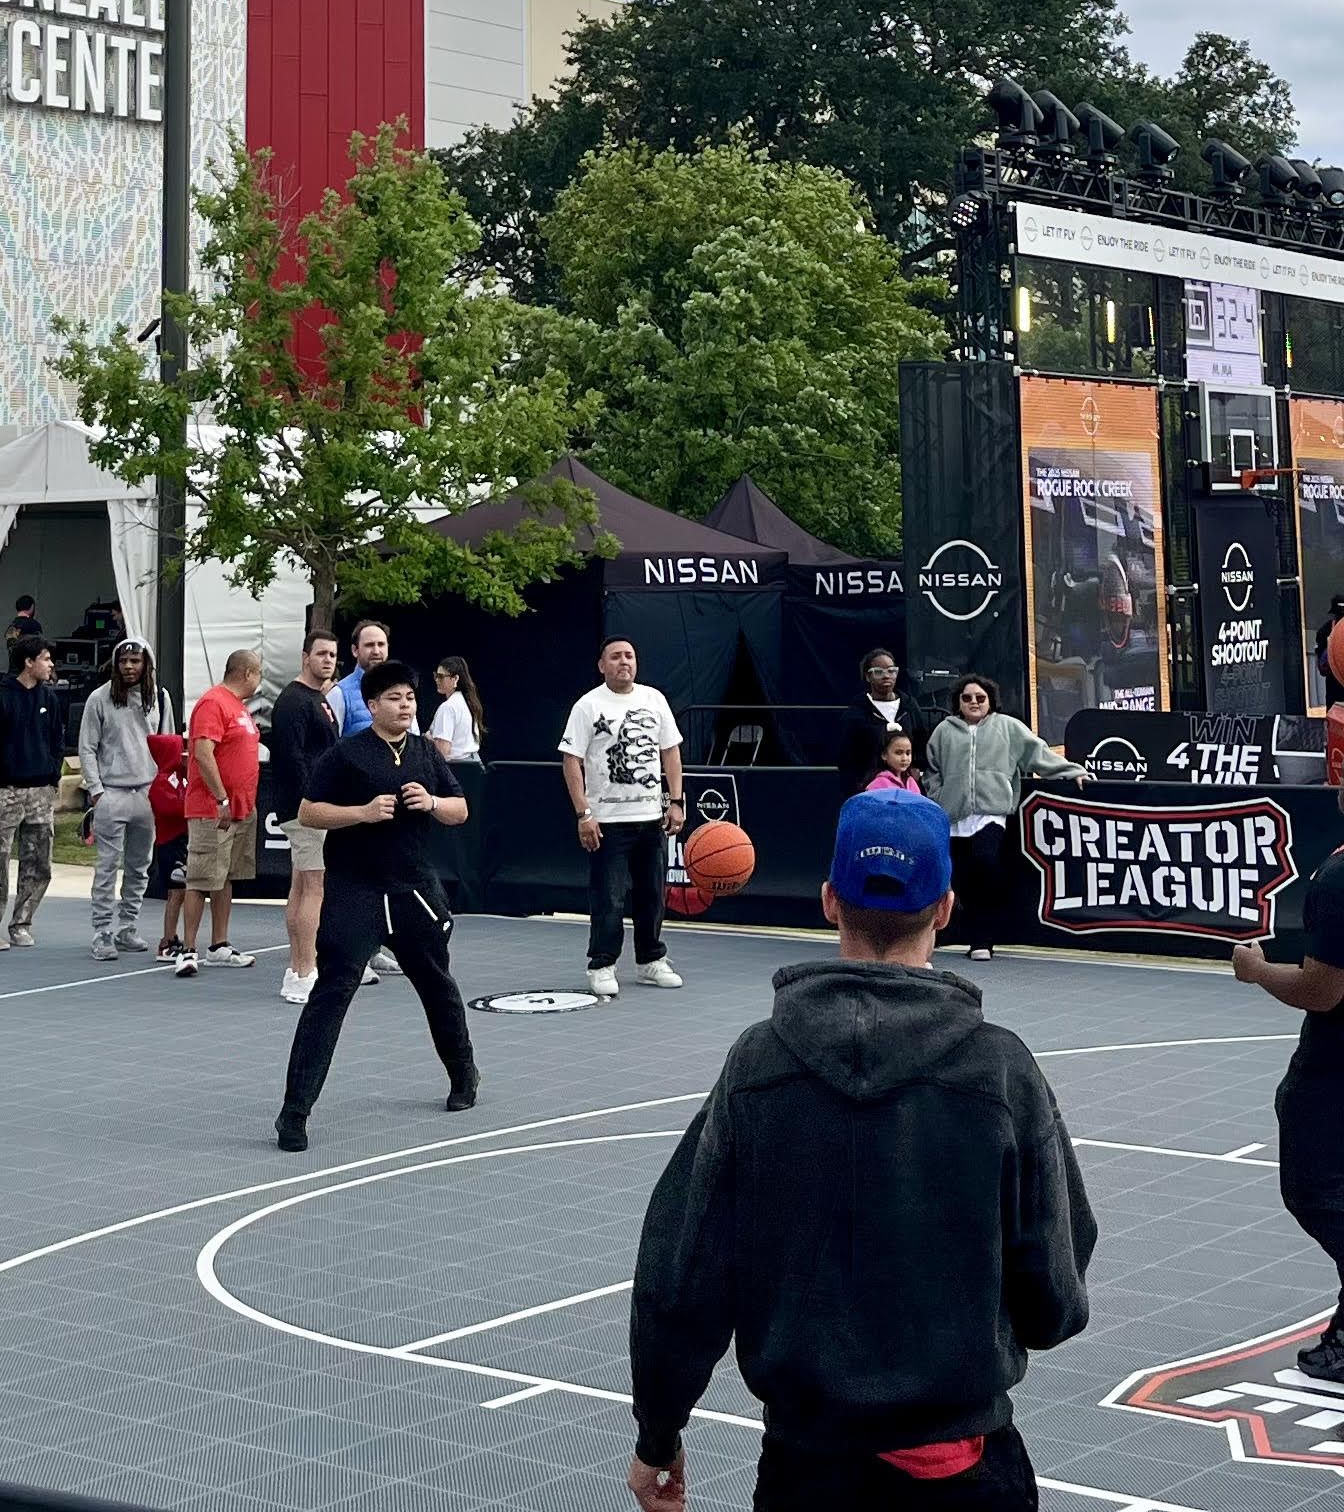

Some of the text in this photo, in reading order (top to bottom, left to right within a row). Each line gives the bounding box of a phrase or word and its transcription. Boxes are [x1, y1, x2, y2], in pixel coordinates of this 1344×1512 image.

[7, 18, 164, 122] CENTE
[1042, 226, 1055, 237] LET
[1056, 228, 1062, 238] IT
[1064, 228, 1076, 240] FLY
[1097, 235, 1119, 247] ENJOY
[1120, 238, 1133, 249] THE
[1134, 240, 1149, 252] RIDE
[1168, 247, 1179, 257] LET
[1186, 250, 1196, 260] FLY
[1214, 254, 1231, 266] ENJOY
[1312, 271, 1327, 283] ENJOY
[1061, 469, 1080, 478] NISSAN
[1037, 479, 1133, 497] ROGUE ROCK CREEK
[1303, 484, 1328, 499] ROGUE
[644, 558, 758, 585] NISSAN
[816, 571, 904, 596] NISSA
[918, 572, 1002, 587] NISSAN
[1222, 571, 1254, 582] NISSAN
[1218, 619, 1262, 642] 4-POINT
[1211, 640, 1269, 666] SHOOTOUT
[1189, 715, 1257, 745] WIN
[1085, 759, 1148, 773] NISSAN
[1166, 742, 1262, 772] 4 THE
[696, 802, 730, 810] NISSAN
[1033, 807, 1278, 866] CREATOR
[1053, 860, 1259, 922] LEAGUE
